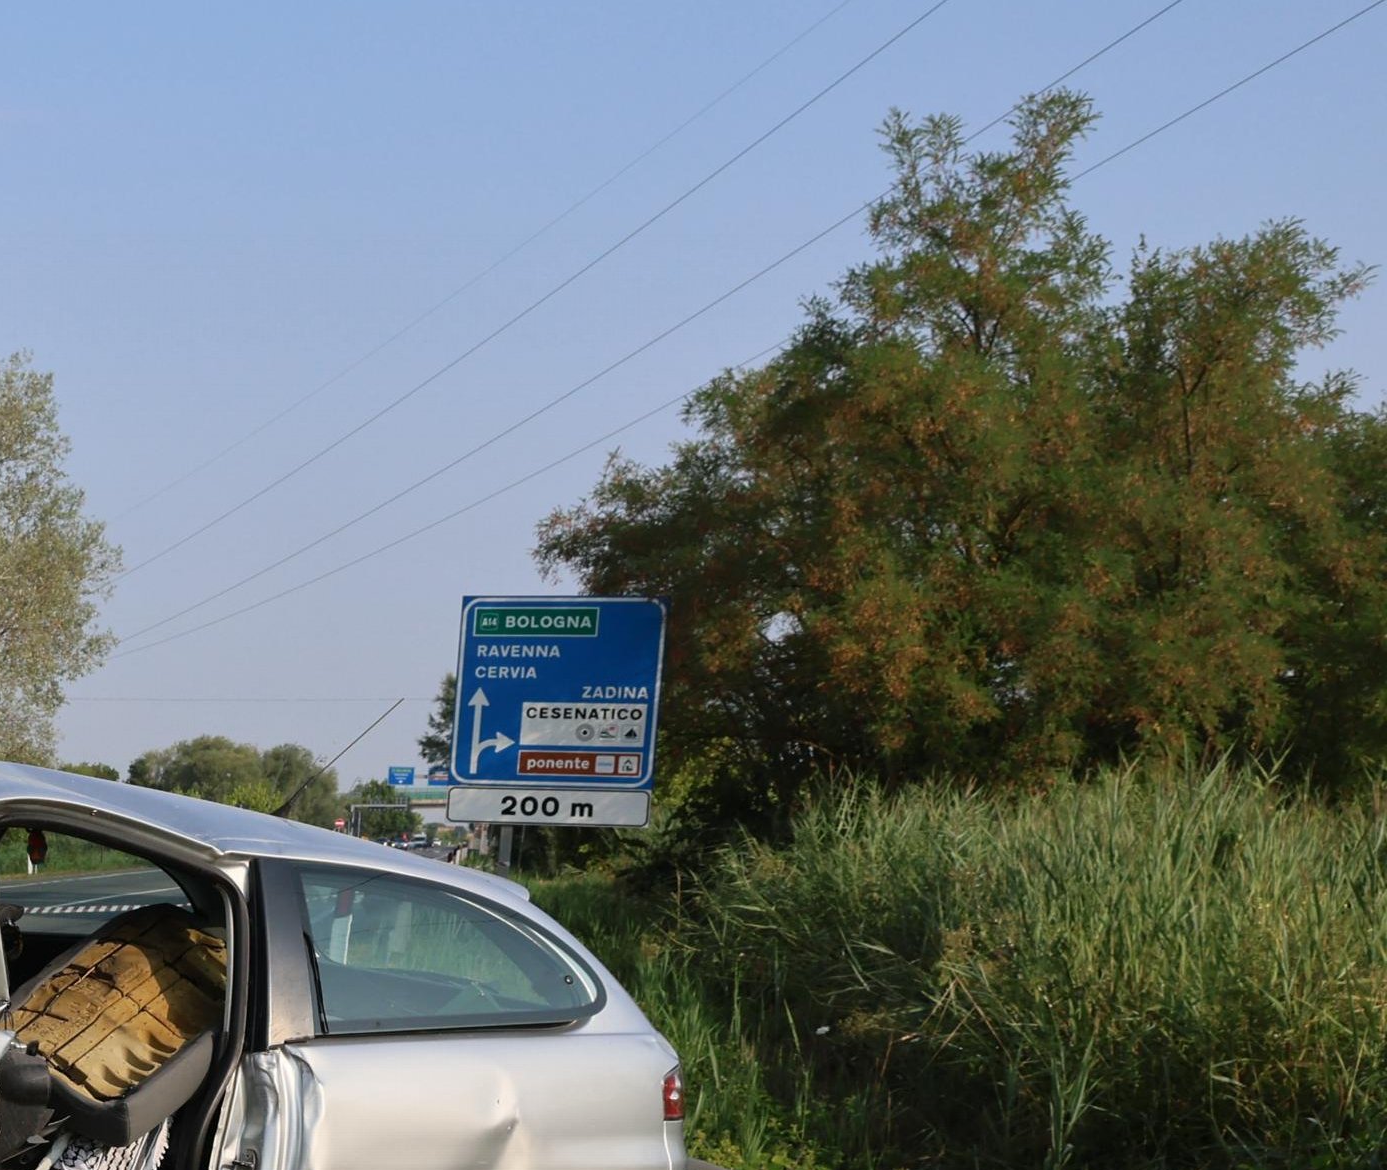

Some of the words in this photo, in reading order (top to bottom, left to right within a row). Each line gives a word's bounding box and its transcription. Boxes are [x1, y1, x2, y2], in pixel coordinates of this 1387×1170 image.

[481, 616, 498, 626] A14
[505, 615, 592, 629] BOLOGNA
[477, 645, 561, 658] RAVENNA
[475, 666, 537, 679] CERVIA
[582, 686, 649, 699] ZADINA
[526, 707, 643, 721] CESENATICO
[526, 757, 590, 770] ponente
[500, 795, 560, 817] 200
[570, 802, 594, 817] m
